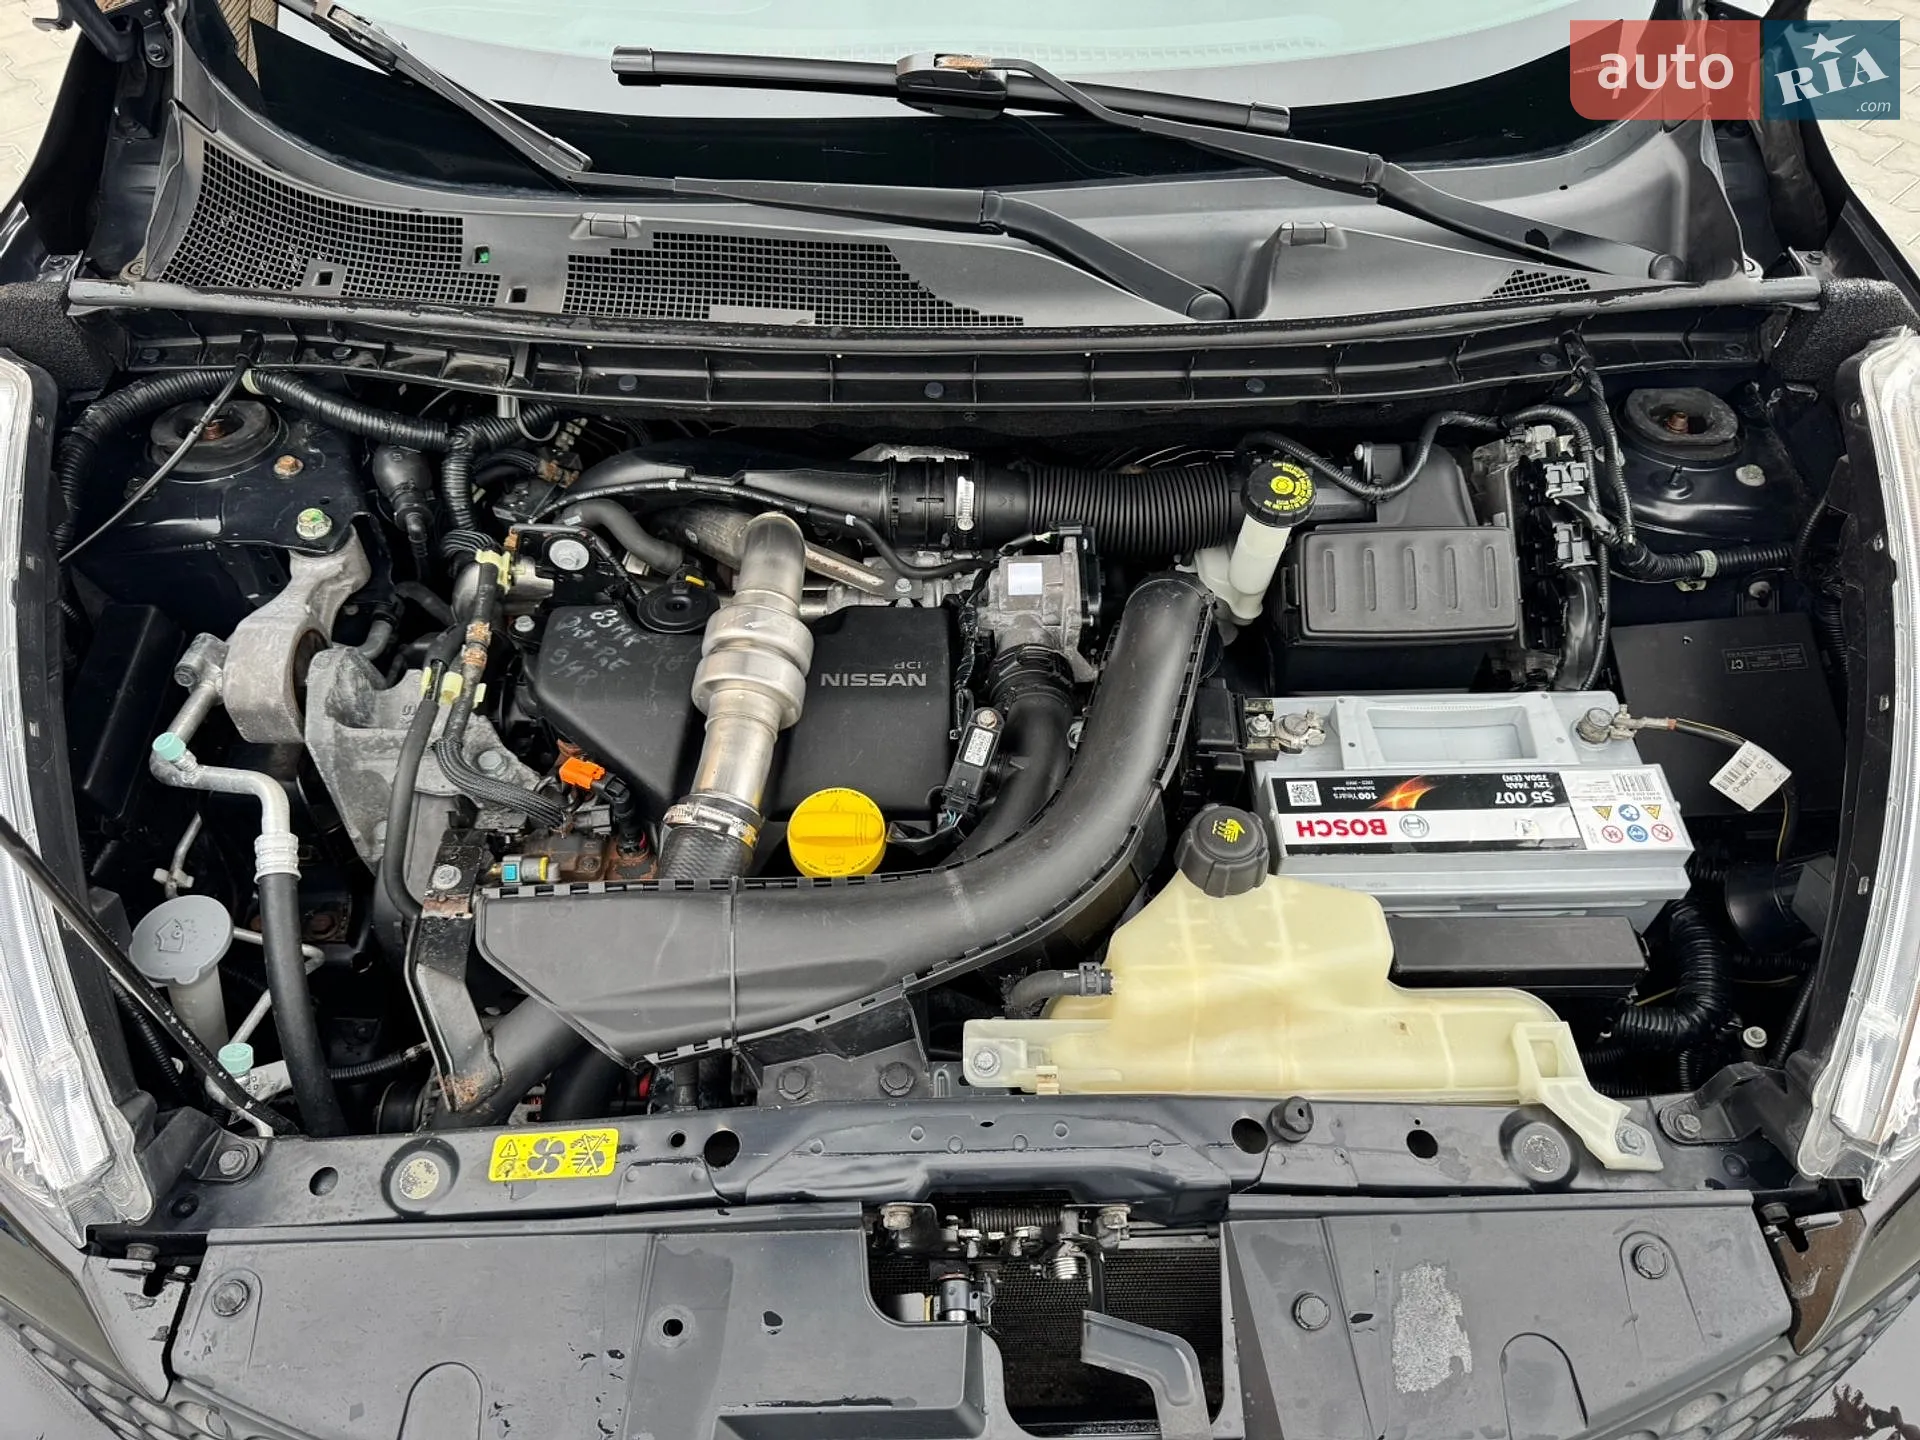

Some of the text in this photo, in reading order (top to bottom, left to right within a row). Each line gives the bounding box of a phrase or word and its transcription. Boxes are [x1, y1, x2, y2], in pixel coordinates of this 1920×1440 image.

[894, 661, 921, 670] dCi
[820, 673, 927, 687] NISSAN
[1534, 781, 1552, 789] 12V
[1332, 791, 1379, 800] 100 Years
[1494, 791, 1527, 804] 007
[1530, 790, 1556, 804] S5
[1296, 818, 1387, 838] BOSCH
